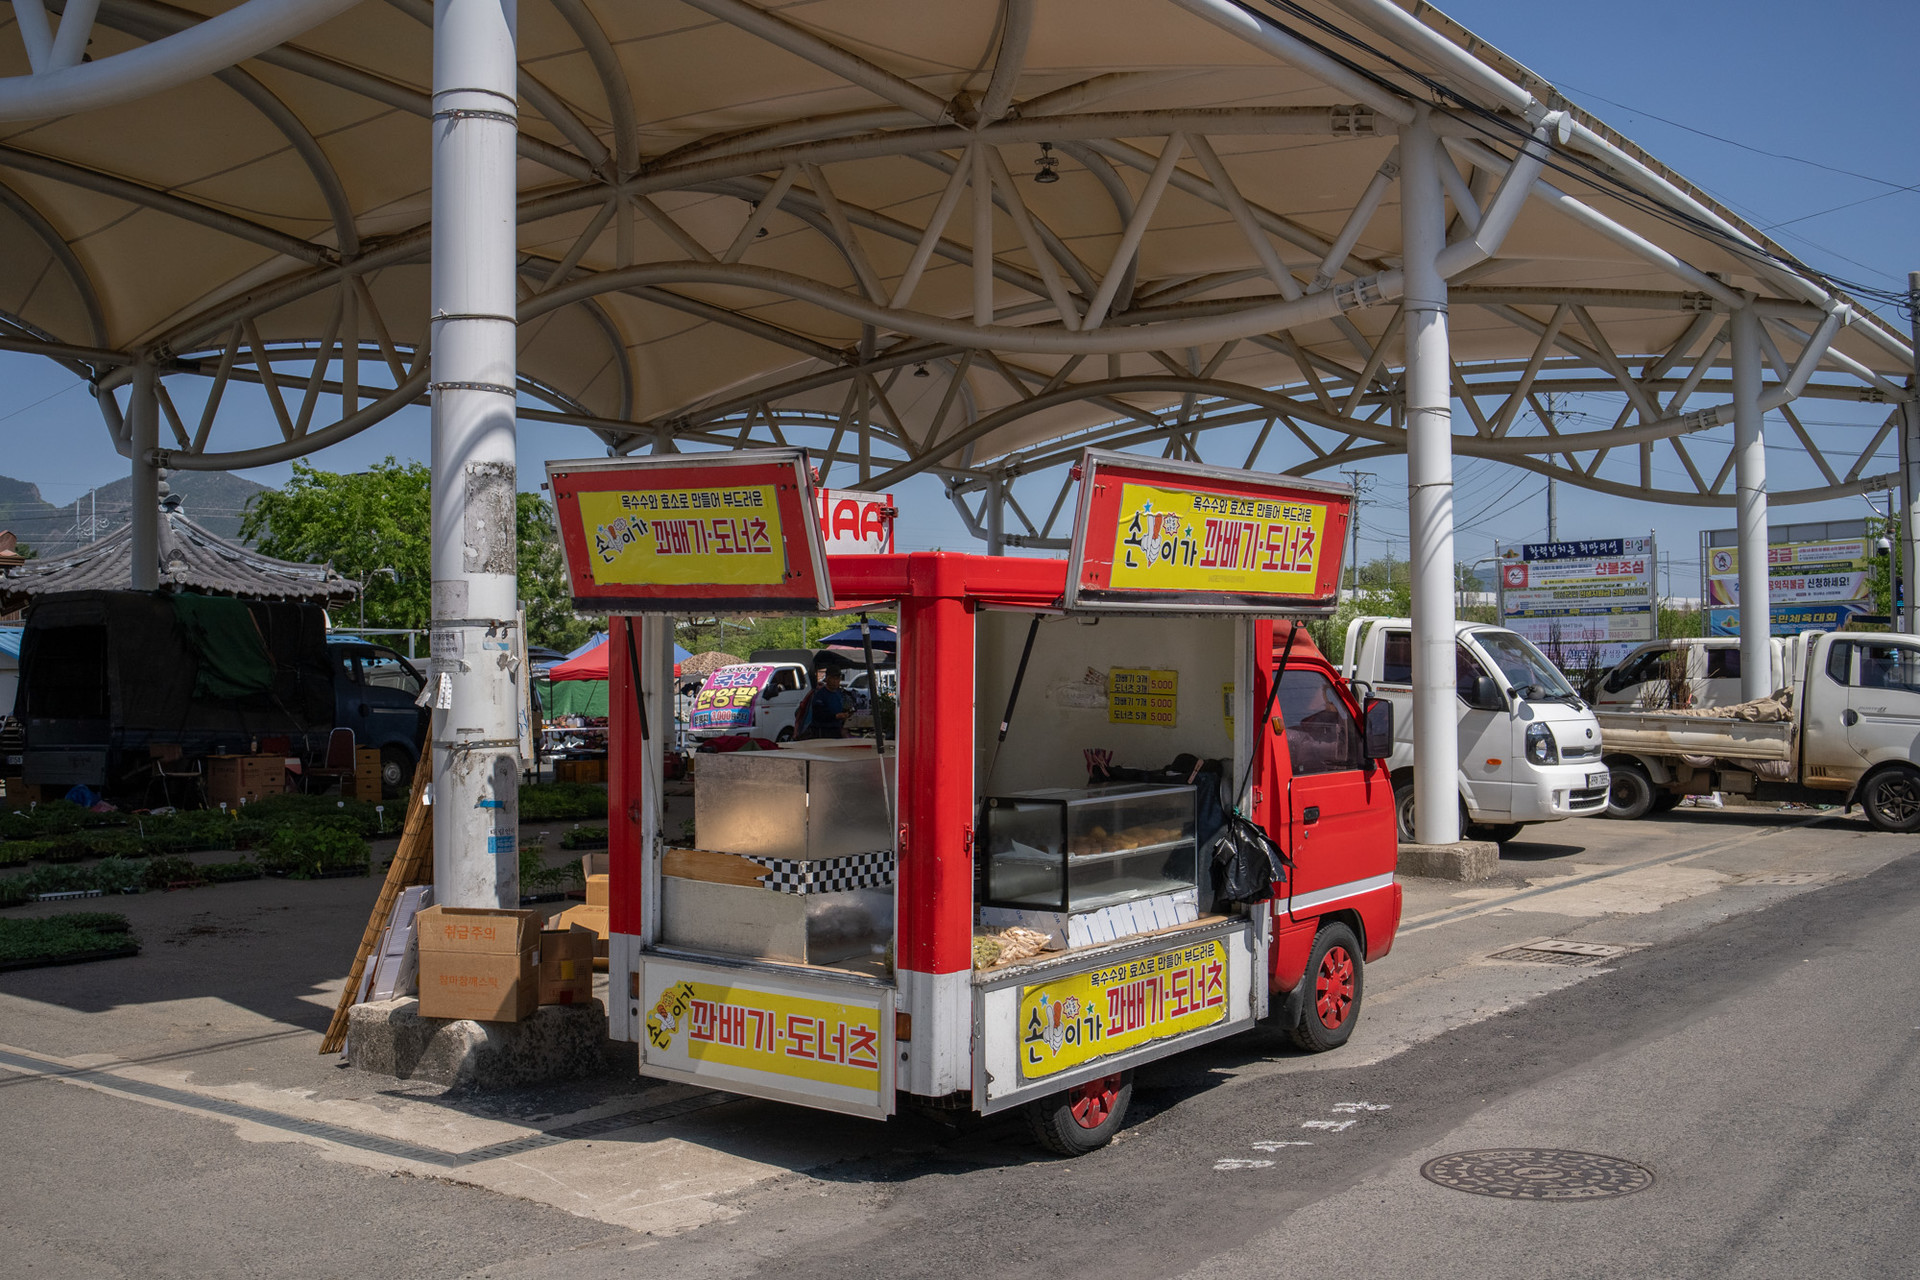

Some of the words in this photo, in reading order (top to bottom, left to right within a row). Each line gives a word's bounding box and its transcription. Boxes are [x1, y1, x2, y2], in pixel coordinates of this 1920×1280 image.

[621, 494, 658, 511] 옥수수와
[660, 493, 690, 510] 효소로
[691, 492, 721, 509] 만들어
[723, 490, 764, 508] 부드러운
[1193, 495, 1227, 515] 옥수수와
[1229, 500, 1255, 517] 효소로
[1256, 503, 1282, 520] 만들어
[1283, 506, 1313, 523] 부드러운
[1625, 539, 1644, 552] 의성
[1595, 560, 1645, 575] 산불조심
[1807, 577, 1850, 589] 신청하세요!
[713, 673, 758, 687] 국산
[696, 686, 760, 711] 면양말
[444, 925, 497, 942] 취급주의
[1091, 966, 1127, 987] 옥수수와
[1129, 959, 1155, 978] 효소로
[1157, 951, 1182, 971] 만들어
[1184, 943, 1216, 963] 부드러운
